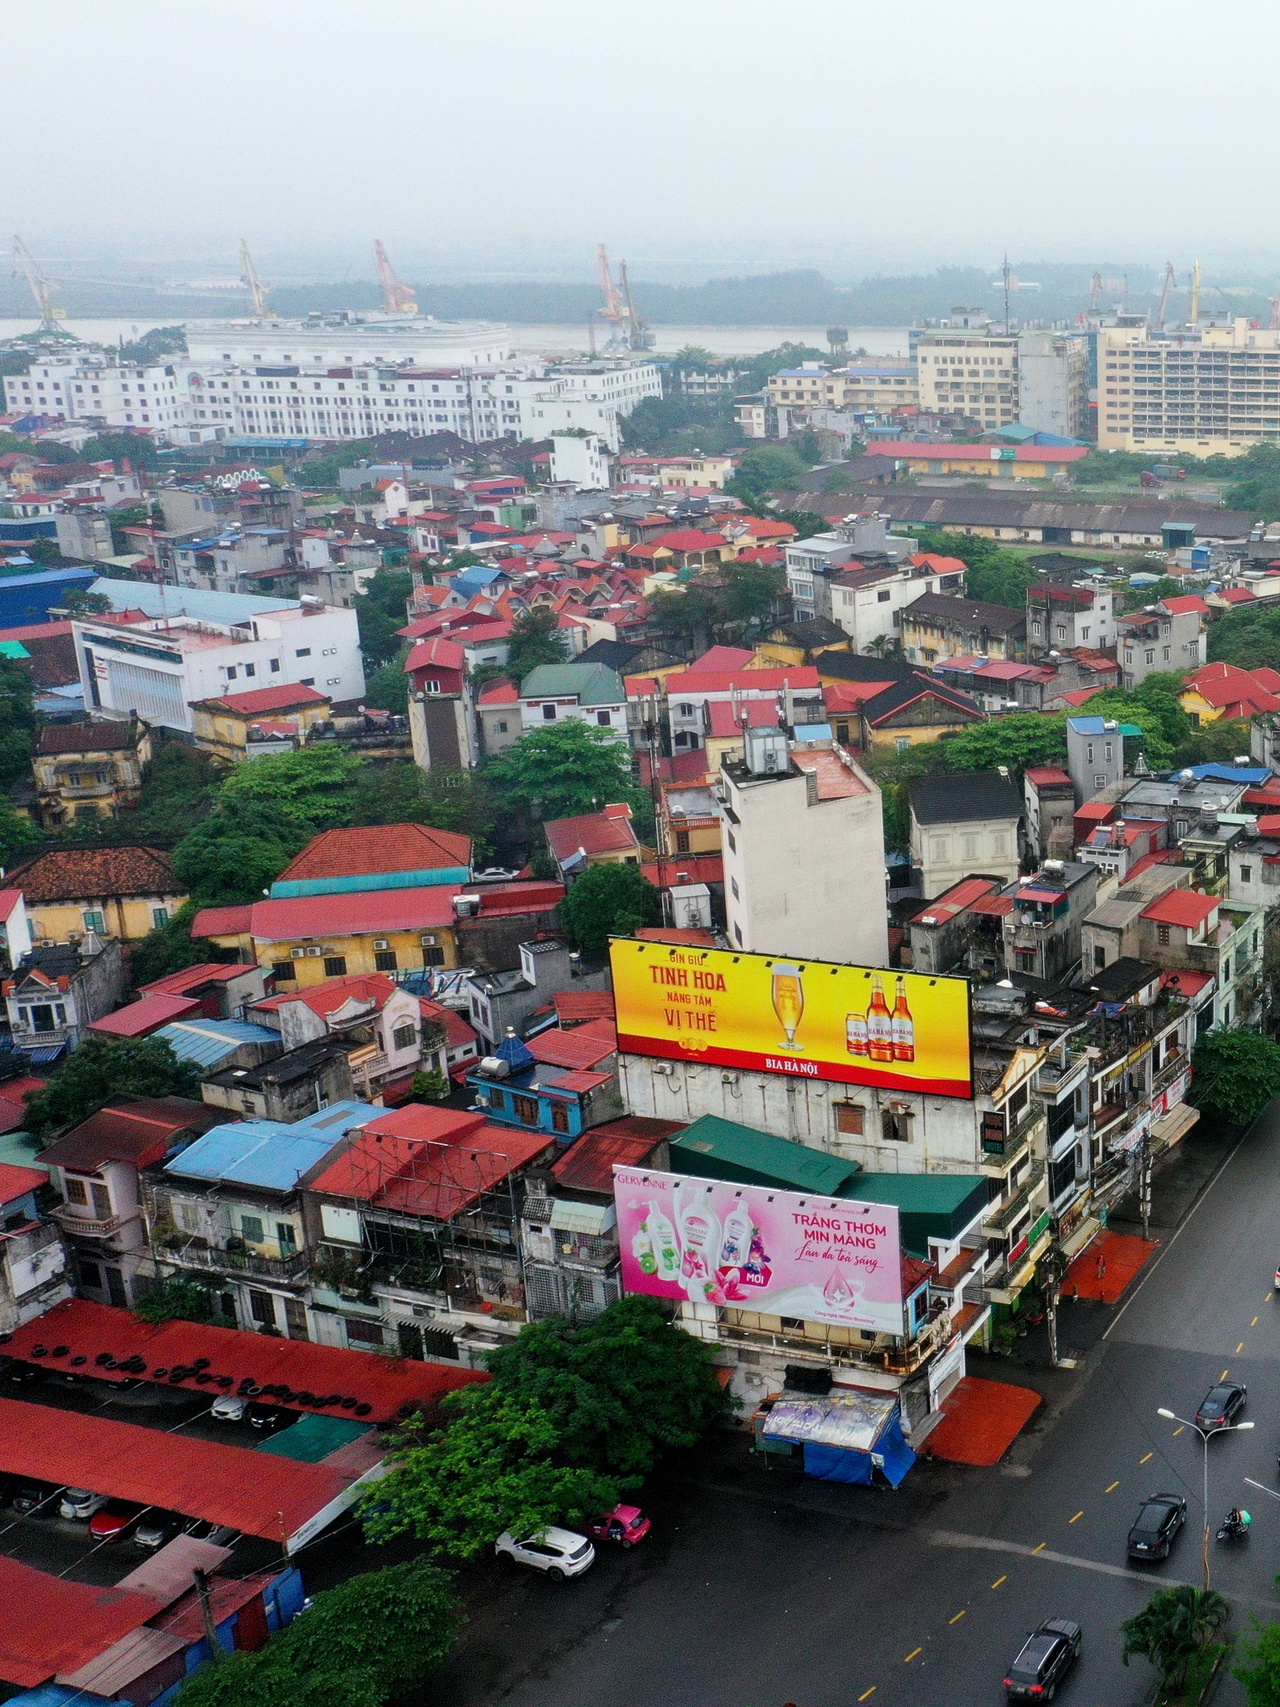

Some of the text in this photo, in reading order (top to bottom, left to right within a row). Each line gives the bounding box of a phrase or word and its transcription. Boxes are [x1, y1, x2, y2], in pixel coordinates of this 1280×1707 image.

[649, 965, 727, 992] TINH HOA
[664, 1008, 717, 1032] VỊ THẾ
[765, 1058, 818, 1076] BIA HÀ NỘI
[617, 1174, 668, 1190] GERVENNE
[792, 1212, 886, 1237] TRẮNG THƠM
[804, 1229, 876, 1249] MỊN MÀNG
[795, 1240, 819, 1262] Làn
[822, 1246, 834, 1260] da
[854, 1255, 884, 1274] sáng
[746, 1272, 764, 1285] MỚI
